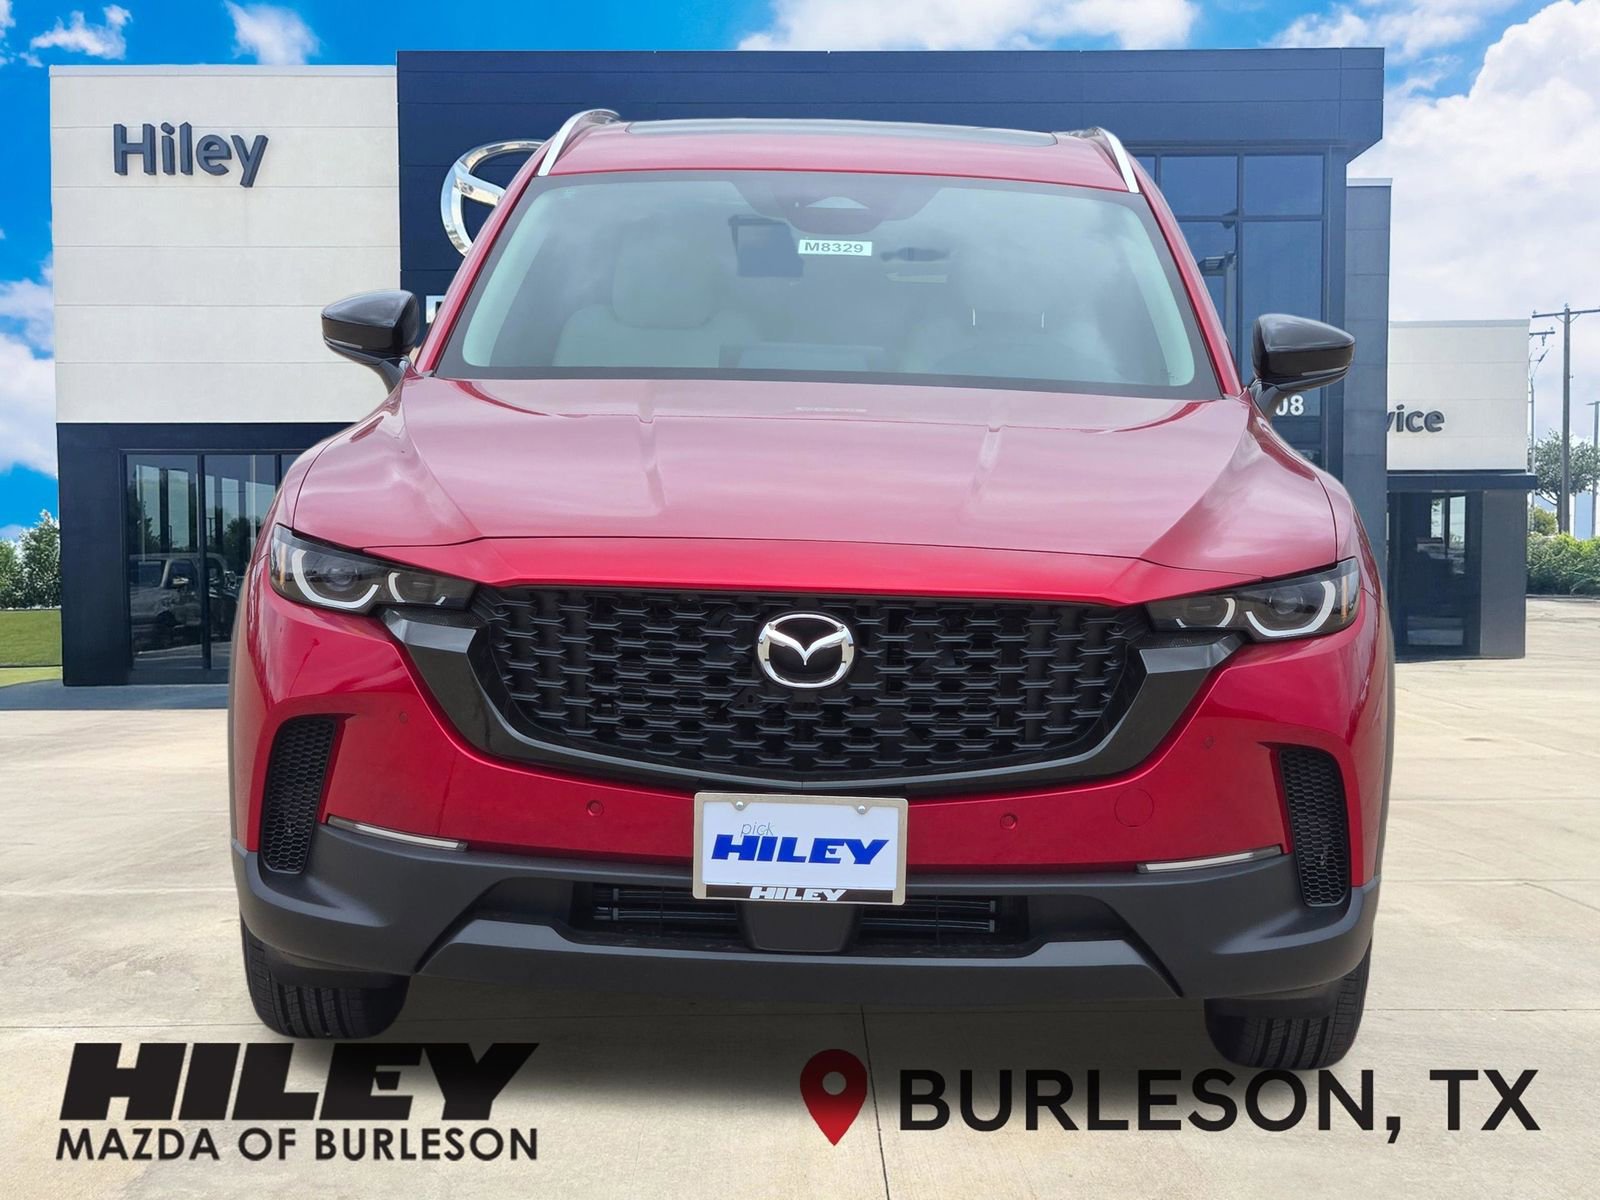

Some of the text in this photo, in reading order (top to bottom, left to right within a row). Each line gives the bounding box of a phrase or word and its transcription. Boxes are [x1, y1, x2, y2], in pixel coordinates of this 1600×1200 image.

[113, 121, 269, 188] Hiley
[804, 242, 864, 253] M8329
[740, 821, 774, 837] pick
[711, 834, 889, 864] HILEY
[749, 886, 847, 901] HILEY
